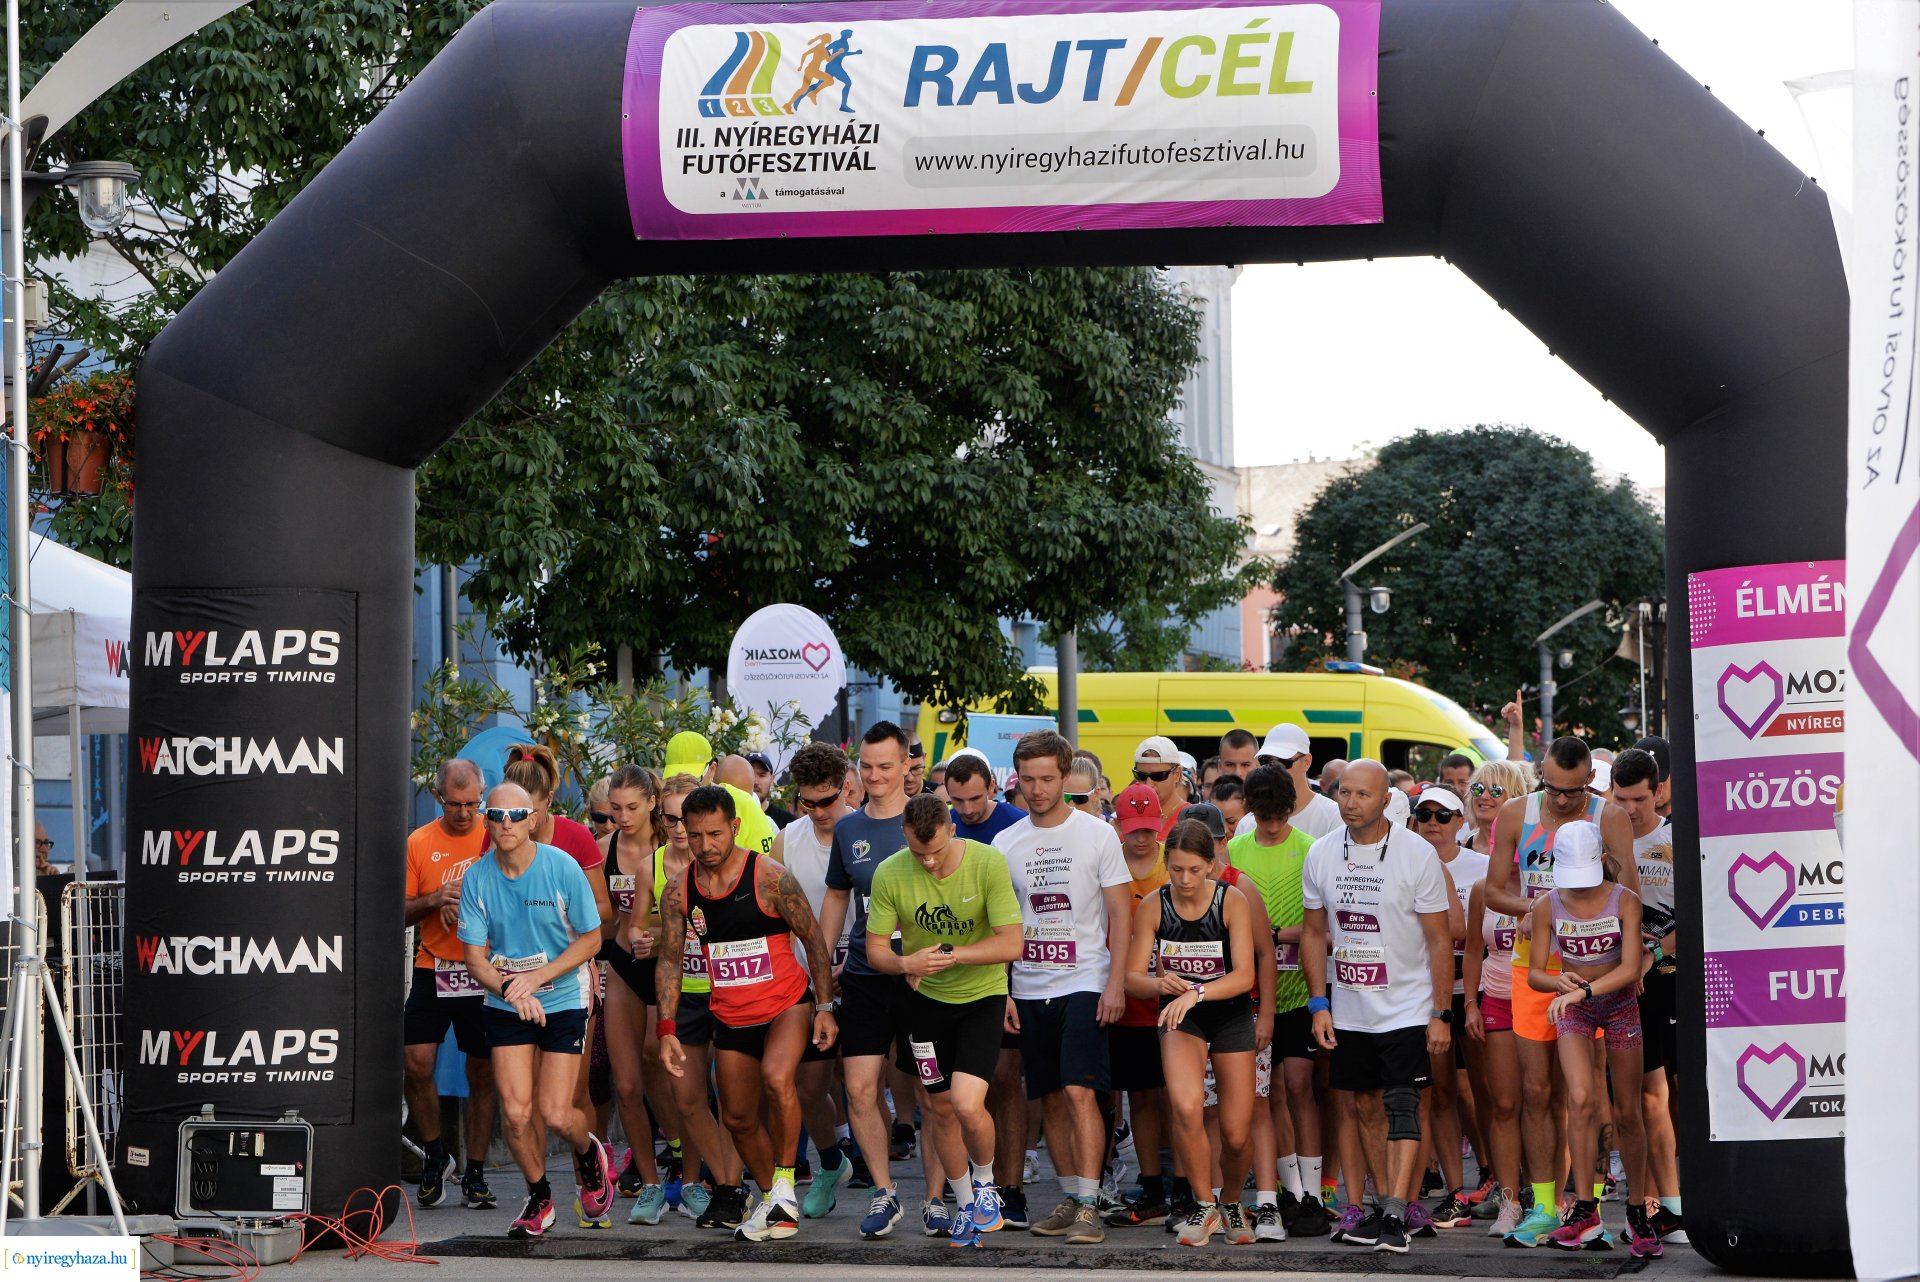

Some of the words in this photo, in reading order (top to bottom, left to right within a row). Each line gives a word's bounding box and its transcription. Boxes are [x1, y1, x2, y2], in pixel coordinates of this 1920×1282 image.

[903, 18, 1313, 108] RAJT/CÉL
[676, 128, 705, 148] III.
[714, 119, 880, 147] NYÍREGYHÁZI
[682, 146, 876, 174] FUTÓFESZTIVÁL
[914, 139, 1305, 174] www.nyiregyhazifutofesztival.hu
[775, 187, 845, 198] támogatásával
[144, 629, 341, 666] MYLAPS
[105, 639, 130, 678] WA
[180, 671, 257, 683] SPORTS
[267, 671, 336, 683] TIMING
[1787, 715, 1844, 731] NYÍREG
[138, 736, 344, 776] WATCHMAN
[141, 829, 340, 866] MYLAPS
[178, 871, 257, 883] SPORTS
[265, 870, 335, 882] TIMING
[1640, 876, 1668, 886] TEAM
[136, 935, 343, 976] WATCHMAN
[1028, 943, 1069, 960] 5195
[1566, 937, 1615, 954] 5142
[719, 958, 762, 978] 5117
[1169, 959, 1216, 973] 5089
[1340, 964, 1379, 982] 5057
[139, 1028, 339, 1066] MYLAPS
[177, 1071, 257, 1084] SPORTS
[265, 1070, 335, 1082] TIMING
